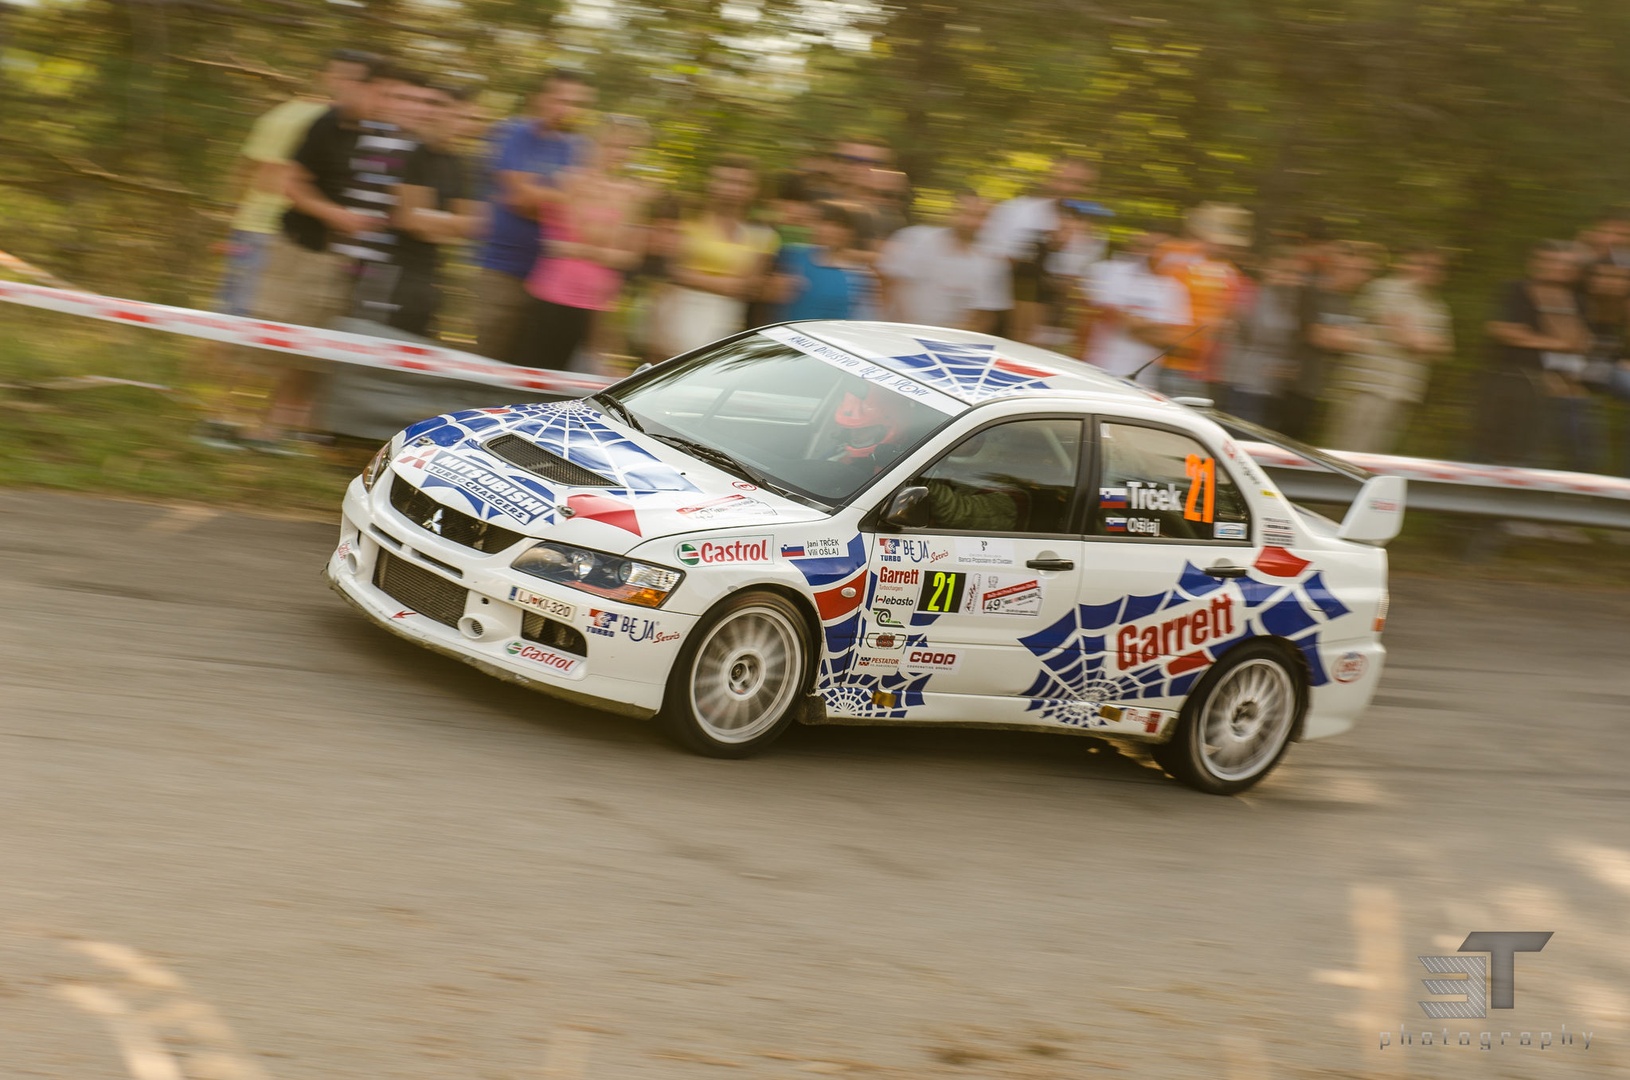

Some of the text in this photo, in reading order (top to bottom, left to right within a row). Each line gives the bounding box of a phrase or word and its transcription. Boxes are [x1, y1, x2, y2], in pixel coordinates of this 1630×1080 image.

[435, 454, 549, 516] MITSUBISHI
[1184, 453, 1216, 524] 21
[1126, 481, 1184, 512] Trček
[701, 539, 769, 564] Castrol
[807, 540, 819, 549] Jani
[880, 554, 902, 562] TURBO
[880, 566, 920, 585] Garrett
[517, 590, 531, 604] LJ
[875, 594, 915, 606] Webasto
[927, 571, 957, 612] 21
[985, 598, 1001, 611] 49
[586, 625, 616, 637] TURBO
[652, 630, 681, 644] Servis
[1116, 593, 1236, 672] Garrett
[520, 645, 575, 672] Castrol
